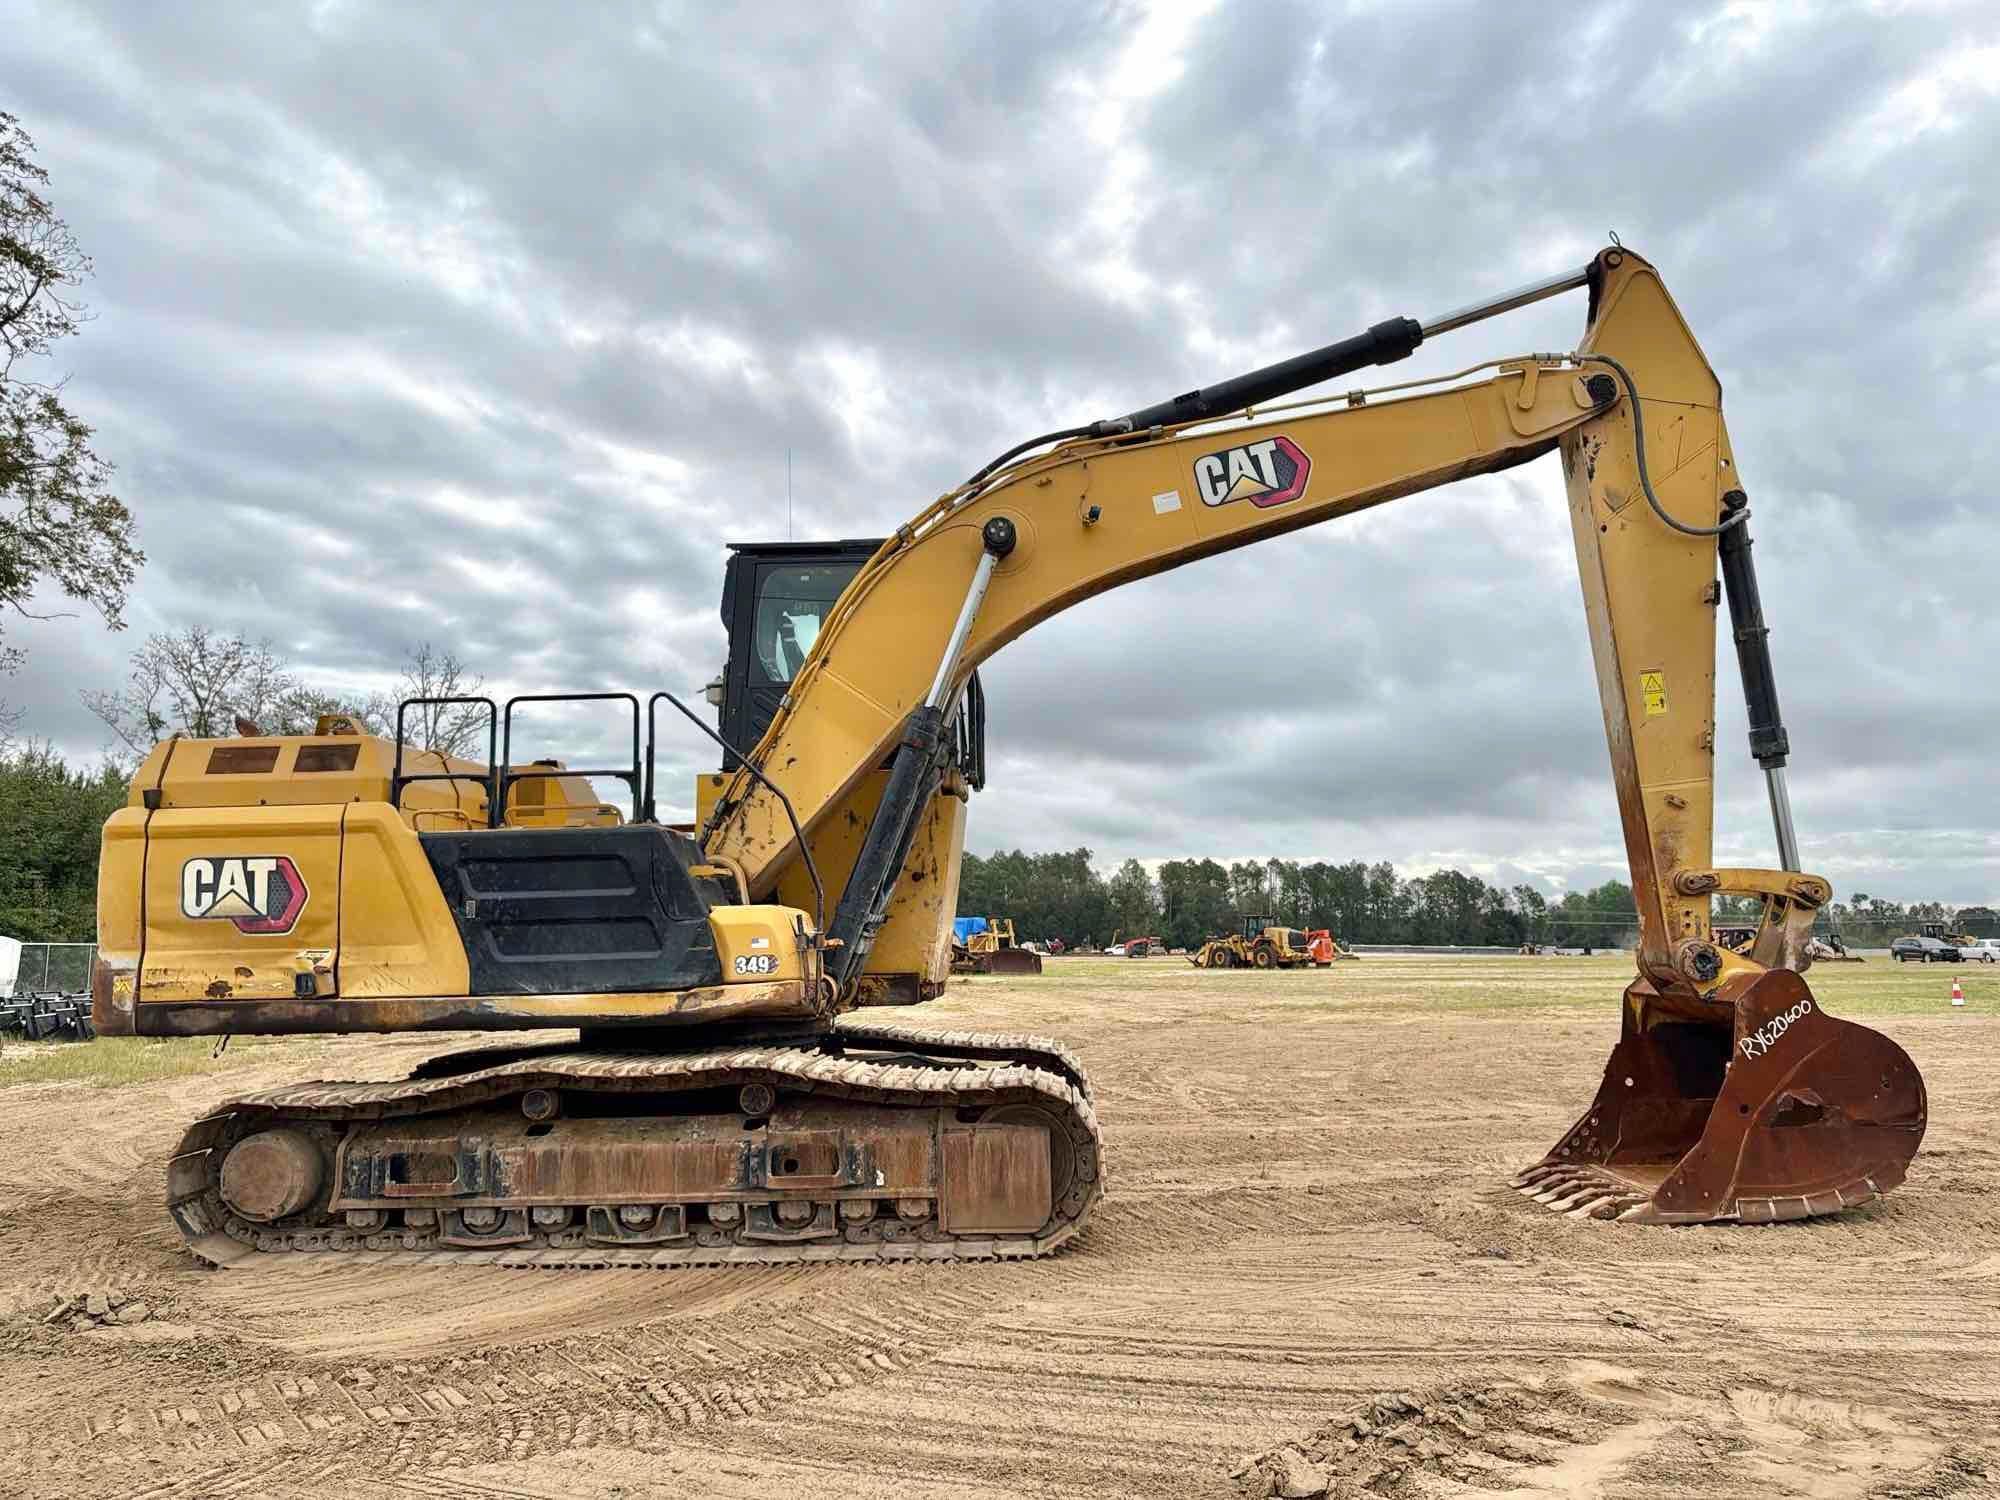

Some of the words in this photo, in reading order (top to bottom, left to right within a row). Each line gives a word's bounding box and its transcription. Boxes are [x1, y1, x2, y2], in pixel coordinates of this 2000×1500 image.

[1194, 439, 1280, 506] CAT
[183, 858, 277, 918] CAT
[735, 955, 769, 974] 349
